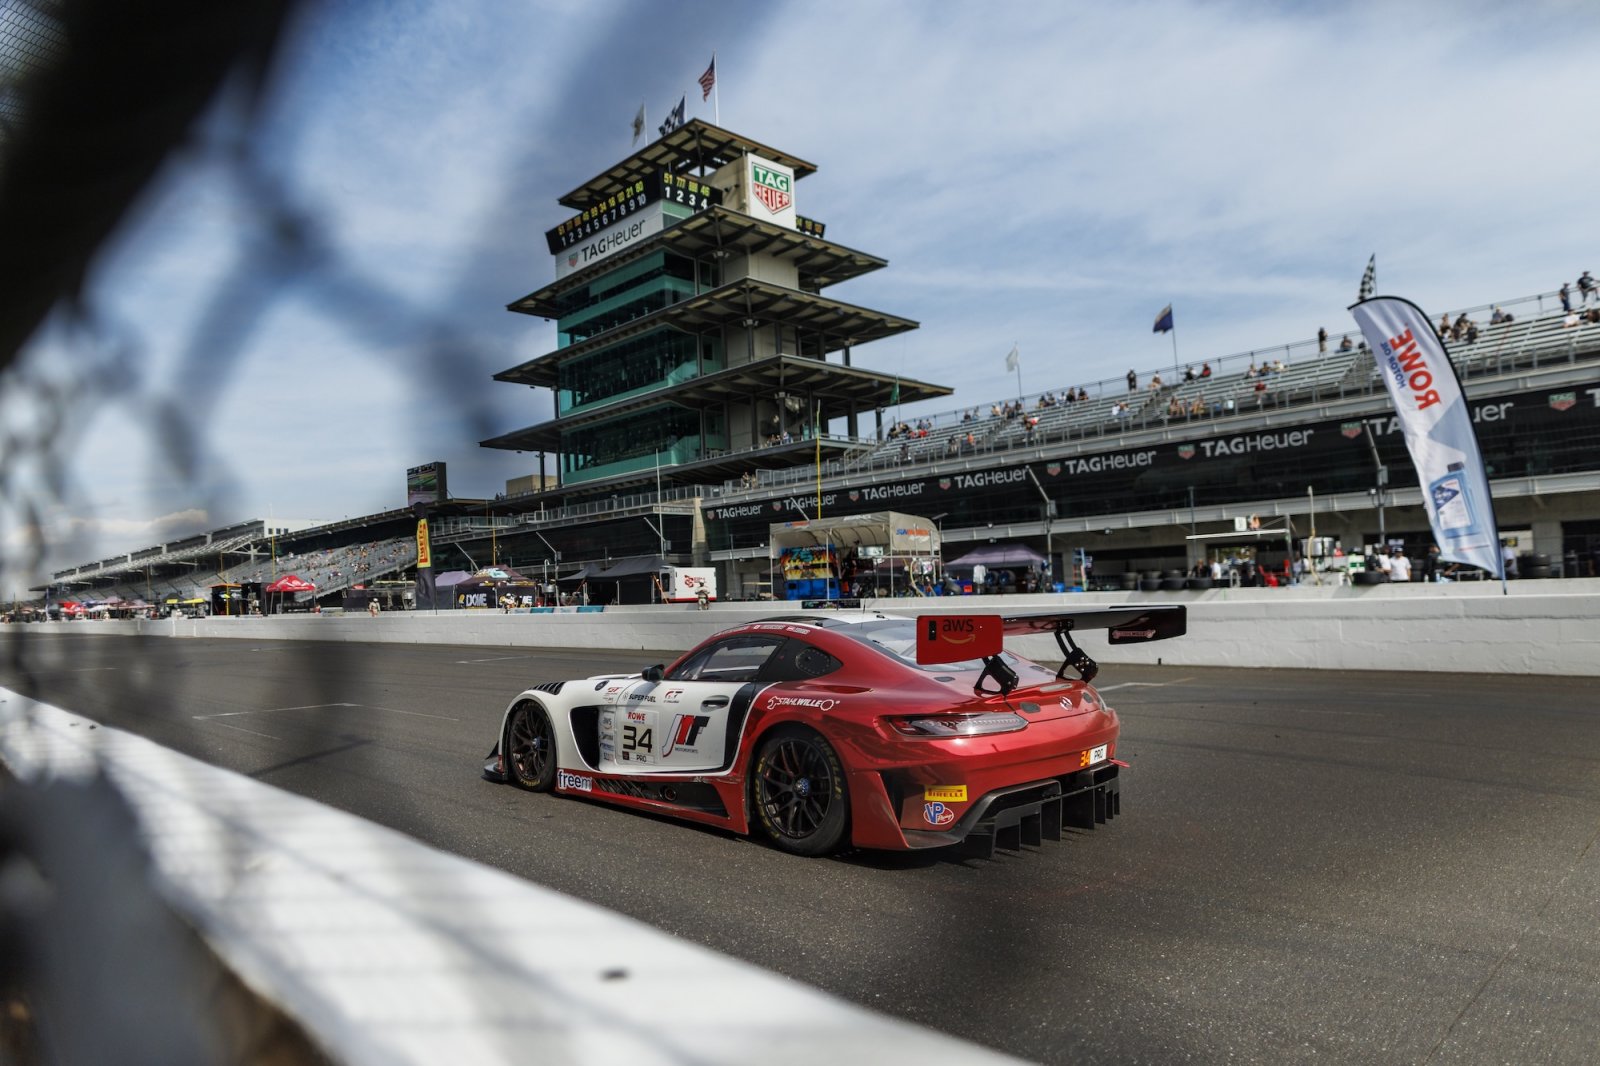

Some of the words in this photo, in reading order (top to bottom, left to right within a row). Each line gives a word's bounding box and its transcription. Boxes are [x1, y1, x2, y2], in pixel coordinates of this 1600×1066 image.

[755, 167, 788, 191] TAG
[665, 186, 671, 198] 1
[676, 190, 684, 203] 2
[689, 194, 697, 206] 3
[701, 199, 708, 210] 4
[754, 184, 790, 211] HEUER
[569, 232, 575, 243] 2
[578, 228, 583, 238] 3
[594, 219, 600, 230] 5
[602, 214, 608, 225] 6
[611, 209, 616, 220] 7
[620, 204, 626, 216] 8
[629, 199, 635, 211] 9
[637, 193, 646, 206] 10
[1200, 429, 1314, 458] TAGHeuer
[1065, 450, 1156, 475] TAGHeuer
[943, 618, 975, 632] aws
[779, 697, 822, 708] STAHLWILLE
[627, 711, 647, 721] ROWE
[622, 725, 653, 753] 34
[636, 754, 647, 762] PRO
[1080, 750, 1090, 767] 34
[558, 770, 592, 790] freem
[928, 788, 963, 798] PIRELLI
[925, 802, 945, 824] VP
